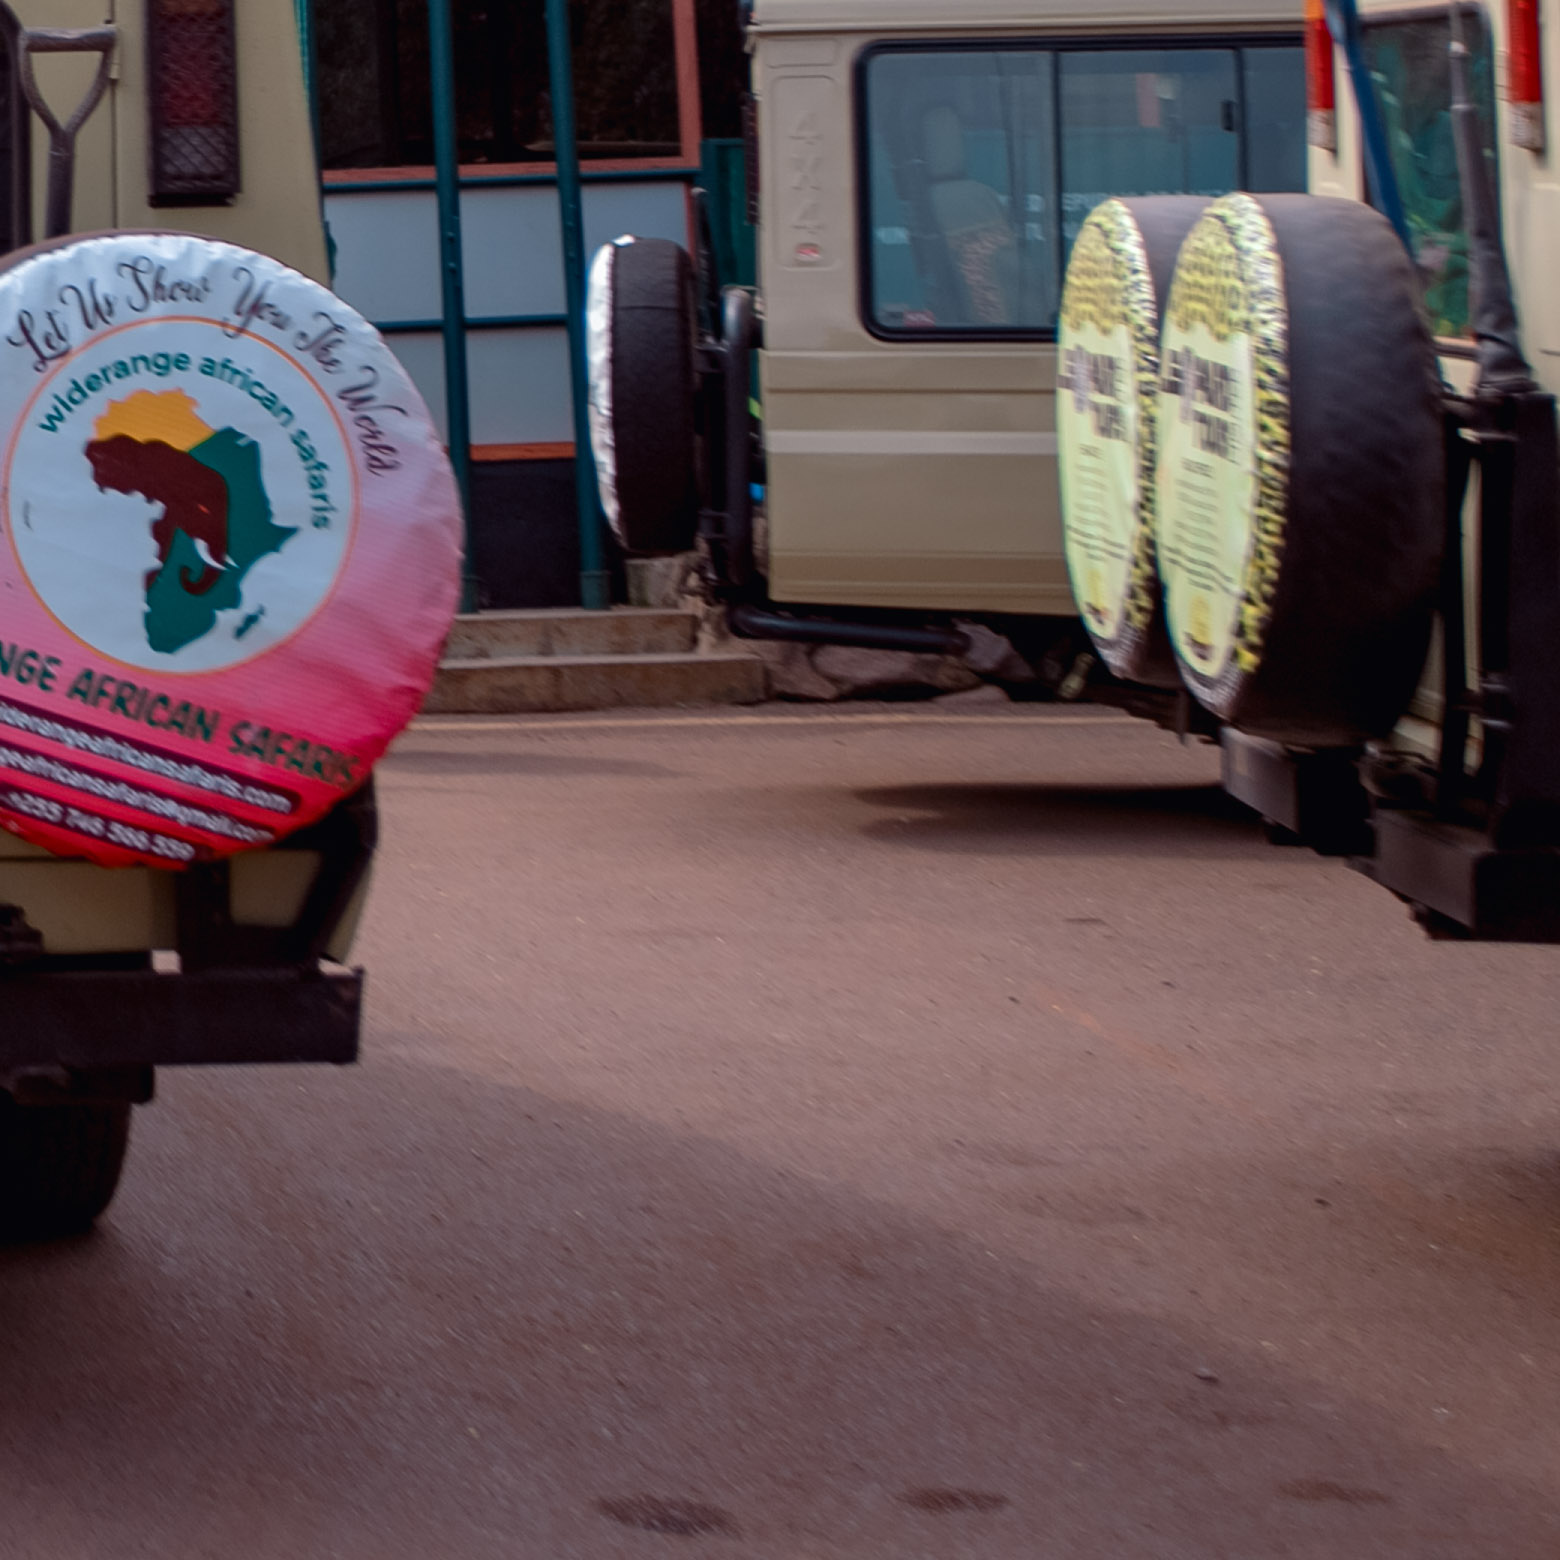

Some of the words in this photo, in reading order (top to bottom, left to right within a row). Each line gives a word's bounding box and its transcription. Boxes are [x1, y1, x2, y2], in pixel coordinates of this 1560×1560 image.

[5, 308, 73, 374] Let
[58, 277, 116, 331] Us
[116, 255, 211, 313] Show
[221, 266, 292, 340] You
[292, 310, 348, 375] The
[336, 364, 409, 478] World
[37, 351, 192, 434] widerange
[198, 356, 296, 428] african
[289, 428, 338, 531] safaris
[67, 668, 220, 743] AFRICAN
[227, 720, 361, 792] SAFARIS
